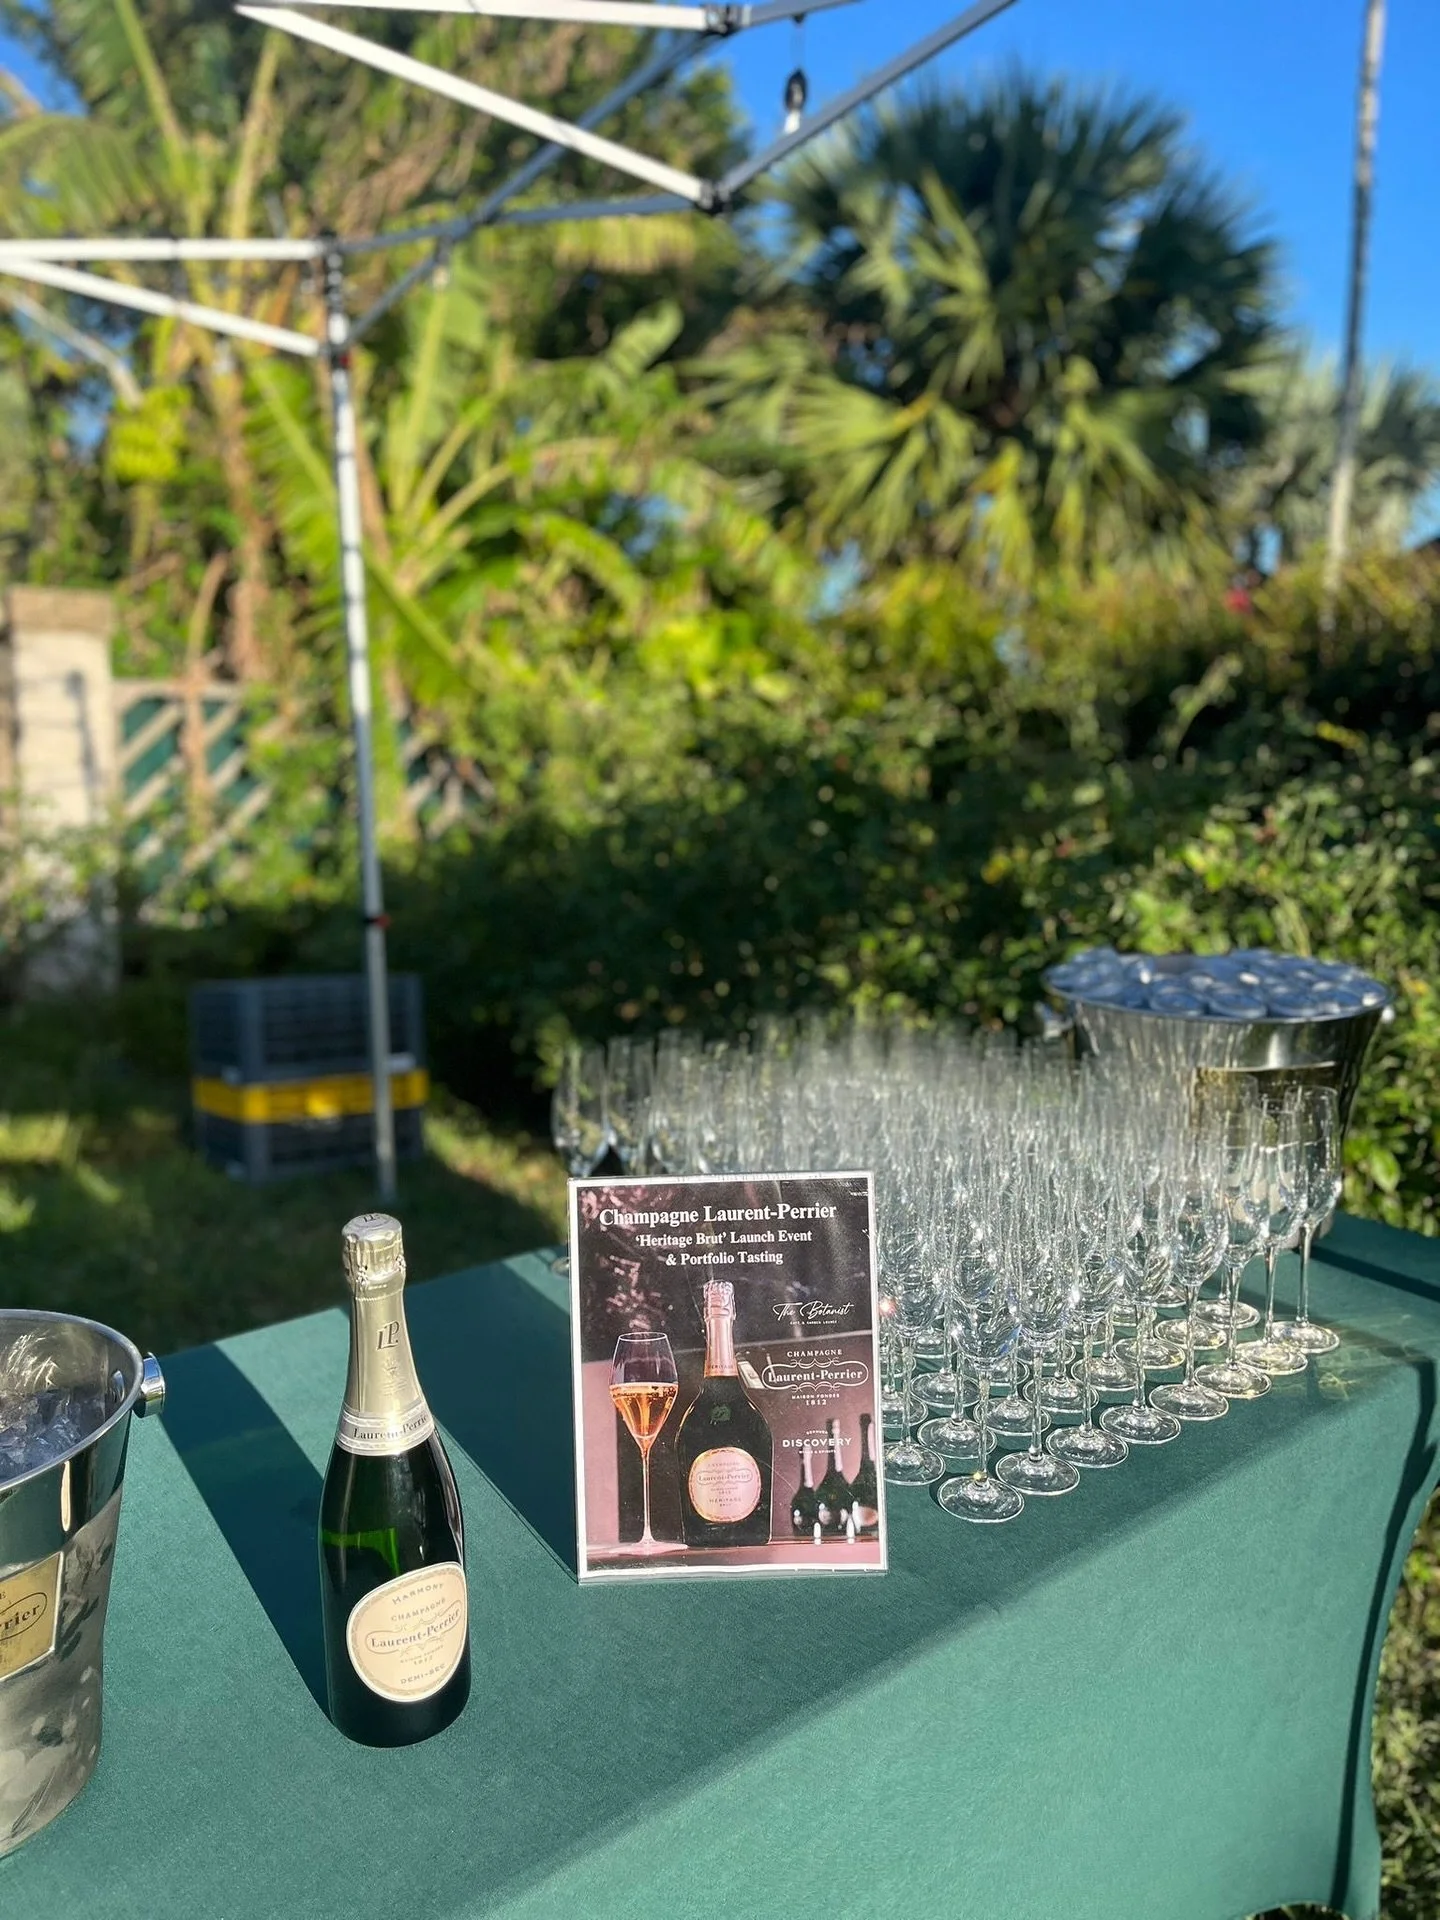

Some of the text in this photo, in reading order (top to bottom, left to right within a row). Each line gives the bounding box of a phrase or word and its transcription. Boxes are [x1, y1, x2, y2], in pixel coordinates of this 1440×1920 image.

[599, 1202, 837, 1228] Champagne Laurent-Perrier
[730, 1231, 775, 1244] Launch
[778, 1229, 812, 1242] Event
[665, 1250, 783, 1266] & Portfolio Tasting
[772, 1300, 855, 1321] The Botanist
[786, 1349, 843, 1358] CHAMPAGNE
[767, 1368, 863, 1383] Laurent-Perrier
[782, 1437, 852, 1448] DISCOVERY
[391, 1582, 445, 1605] HARMONY
[390, 1597, 447, 1622] CHAMPAGNE
[371, 1608, 461, 1649] Laurent-Perrier
[400, 1663, 446, 1685] DEMI-SEC
